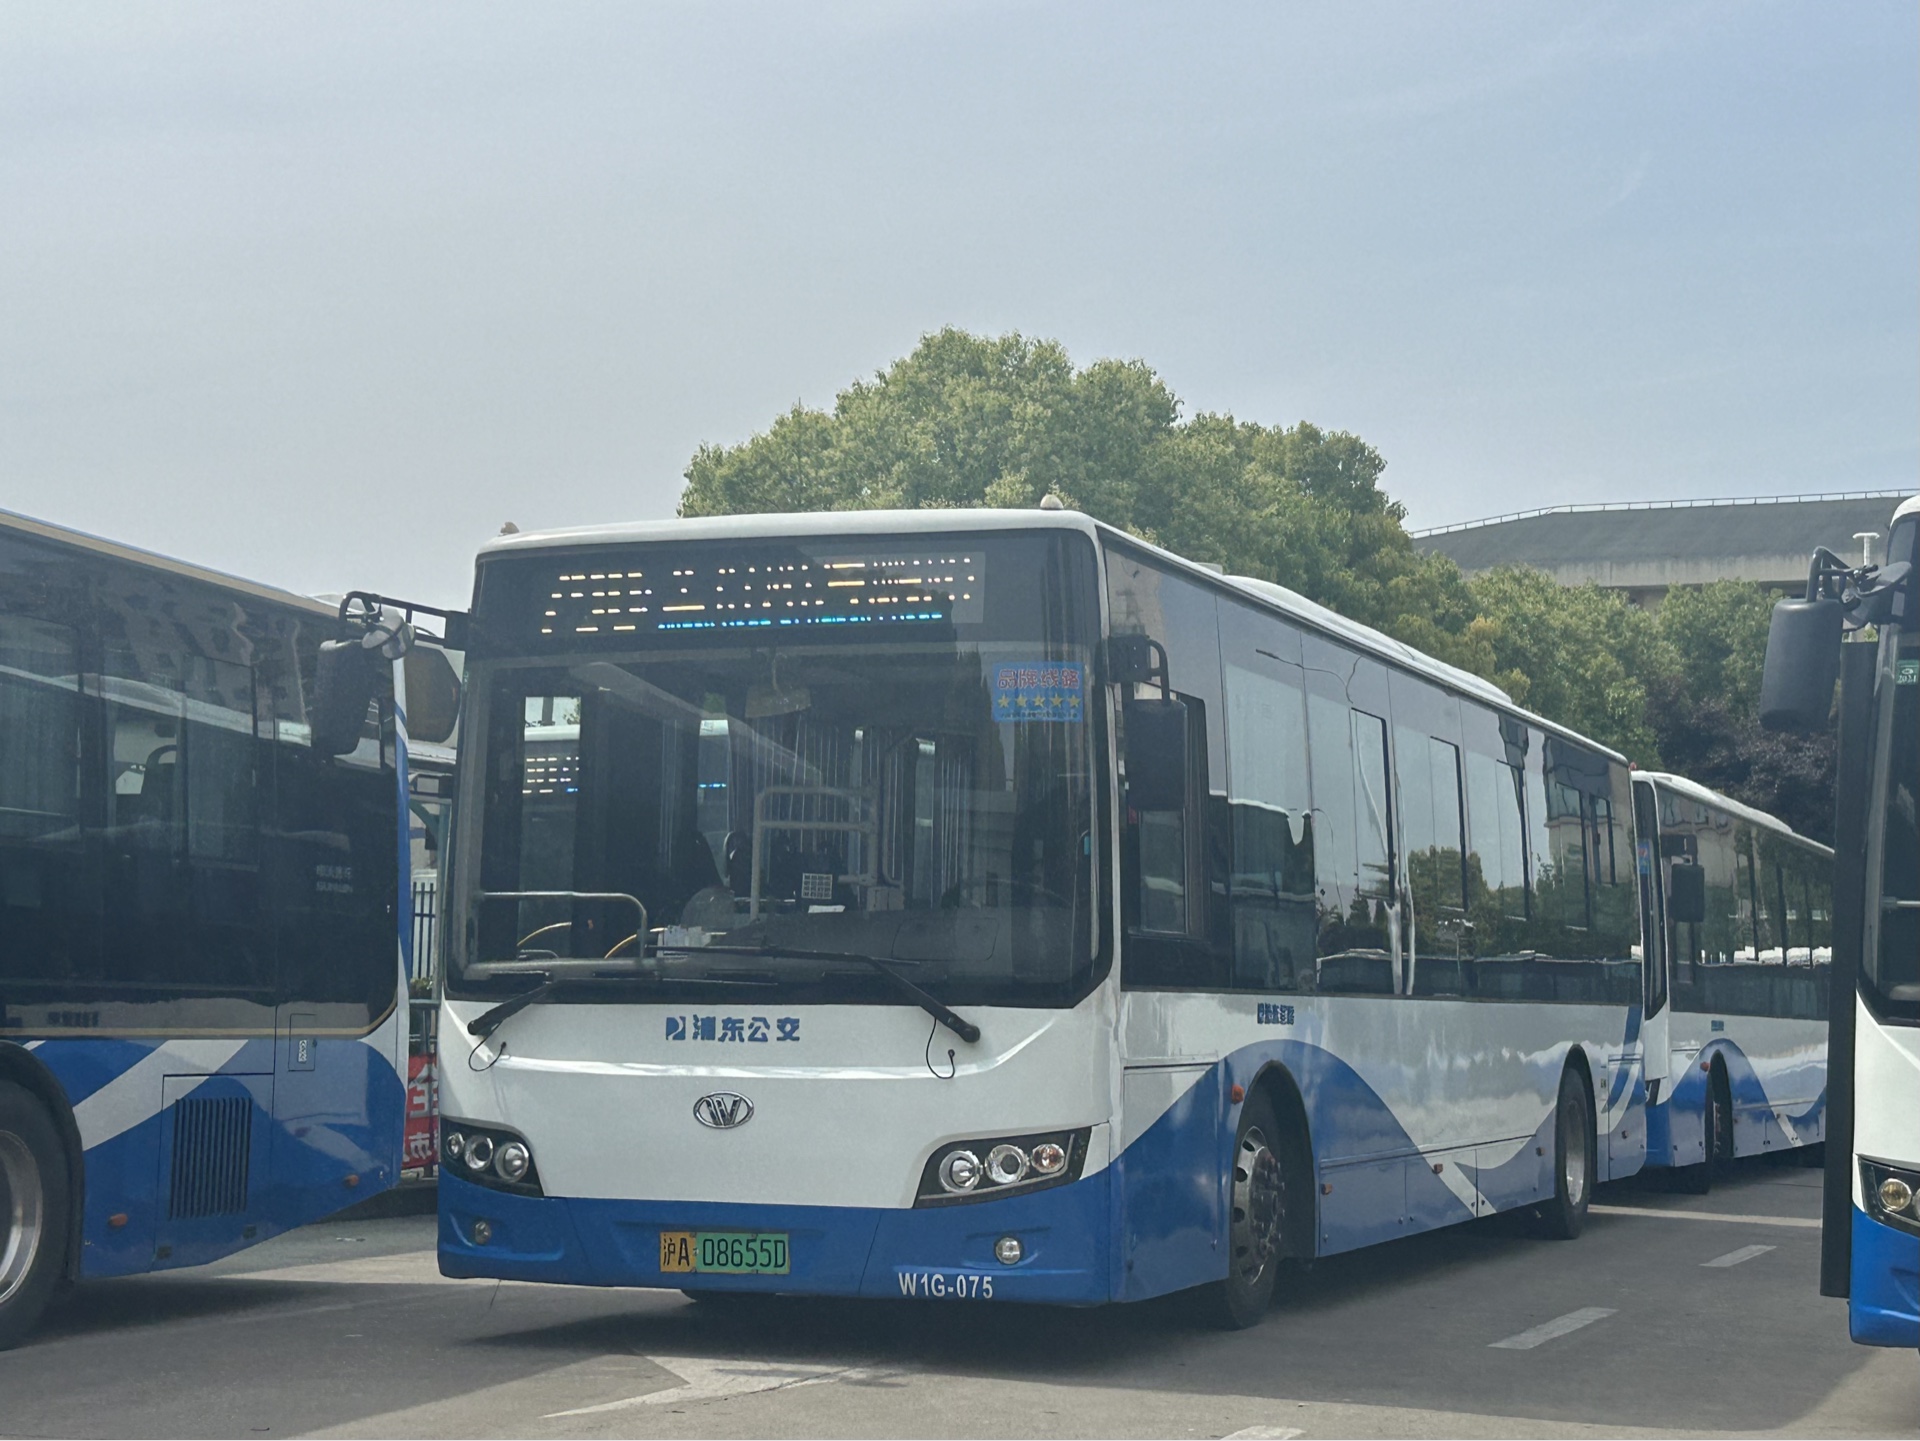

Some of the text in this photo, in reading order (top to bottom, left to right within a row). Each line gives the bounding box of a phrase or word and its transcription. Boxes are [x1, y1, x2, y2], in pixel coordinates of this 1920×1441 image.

[692, 1014, 800, 1042] 浦东公交
[898, 1272, 993, 1298] W1G-075
